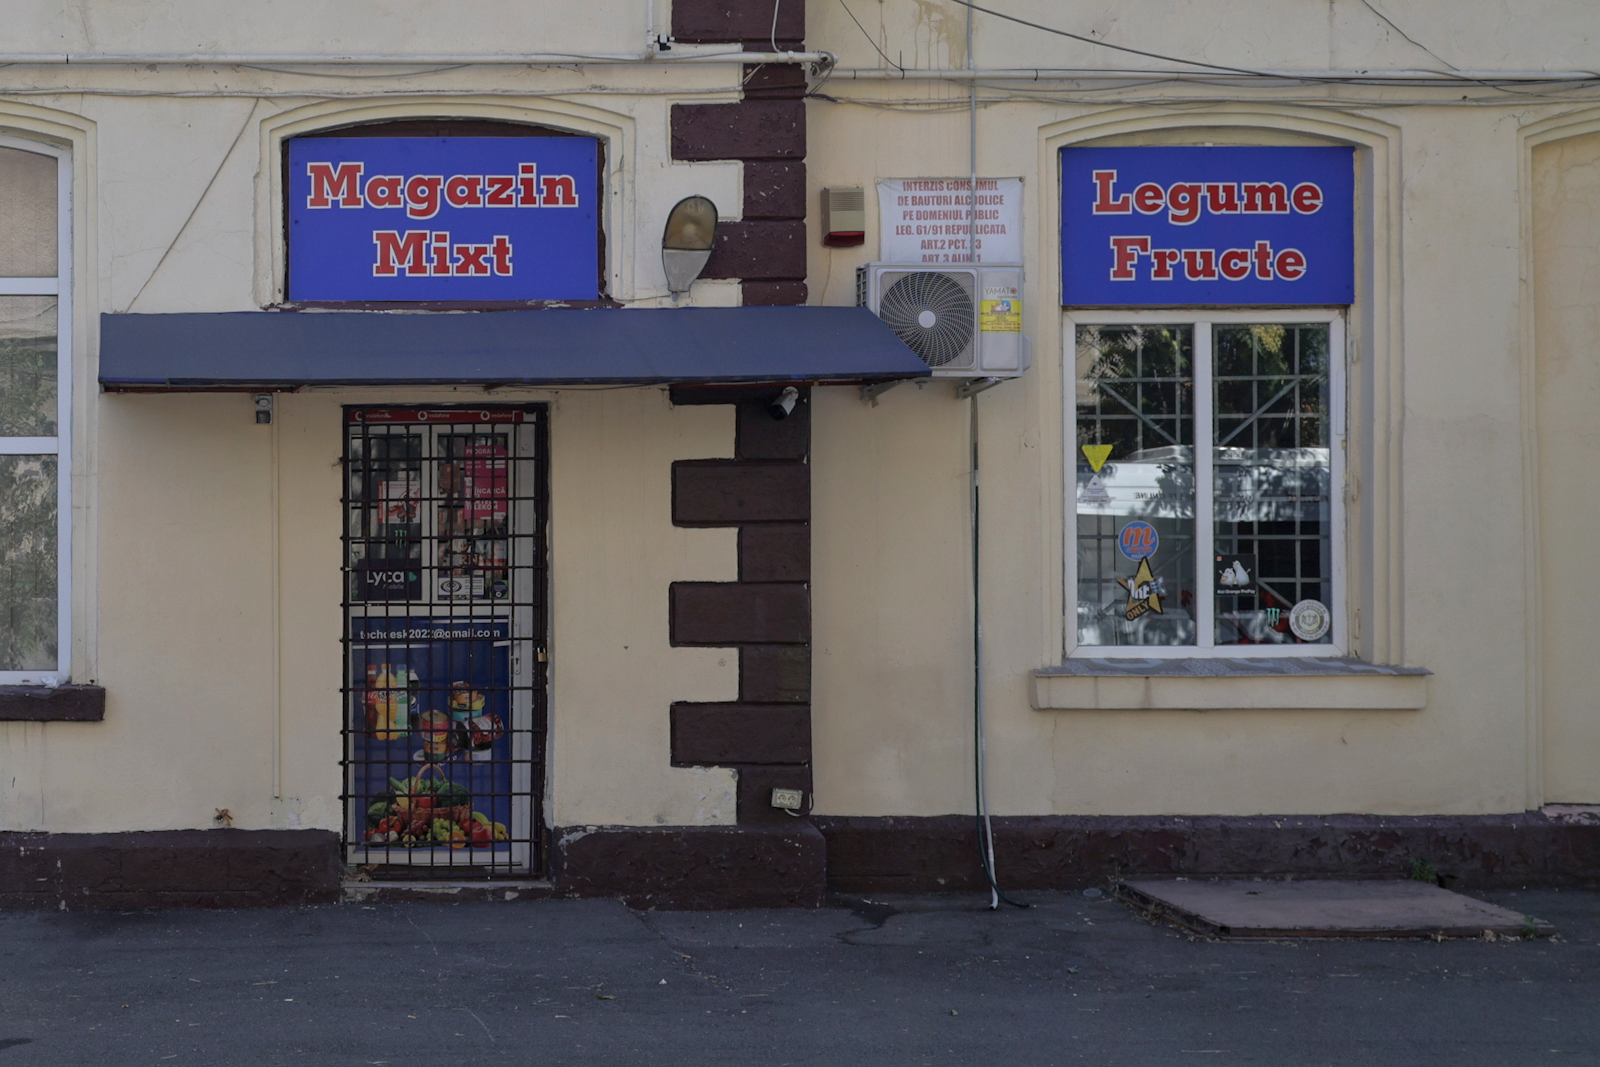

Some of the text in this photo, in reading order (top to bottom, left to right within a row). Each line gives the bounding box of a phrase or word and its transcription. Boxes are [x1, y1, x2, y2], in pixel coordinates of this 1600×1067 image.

[307, 161, 579, 220] Magazin
[902, 181, 944, 191] INTERZIS
[897, 196, 909, 206] DE
[911, 195, 952, 206] BAUTURI
[1092, 169, 1323, 225] Legume
[903, 210, 914, 220] PE
[915, 210, 963, 220] DOMENIUL
[896, 224, 1006, 235] LEG. 61/91 REPULICATA
[948, 239, 967, 249] PCT.
[372, 230, 513, 277] Mixt
[1109, 235, 1307, 281] Fructe
[366, 570, 404, 586] Lyca
[1126, 600, 1150, 621] ONLY
